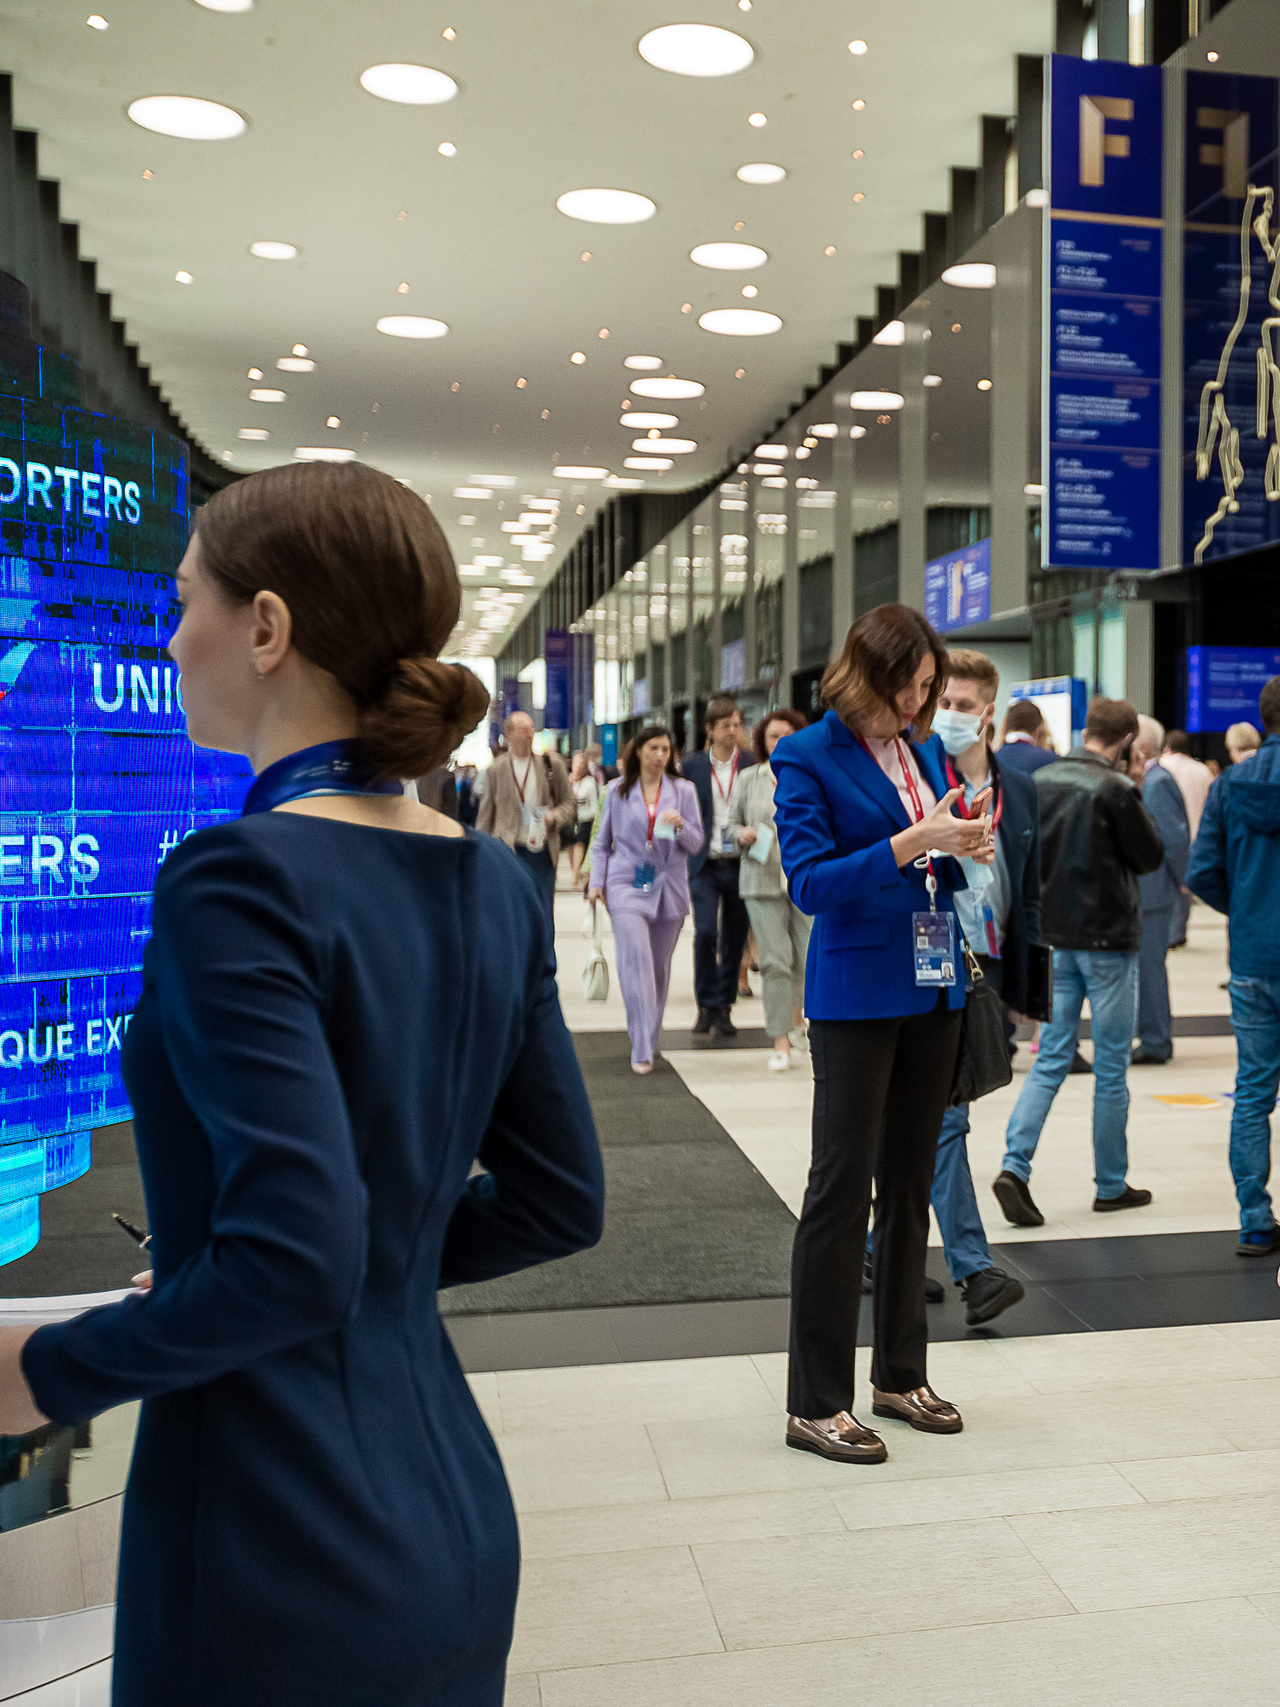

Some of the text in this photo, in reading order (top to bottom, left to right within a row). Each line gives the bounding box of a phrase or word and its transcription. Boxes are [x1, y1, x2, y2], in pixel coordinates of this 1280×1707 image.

[1079, 94, 1134, 187] F
[0, 457, 142, 526] ORTERS
[0, 1022, 76, 1069] QUE
